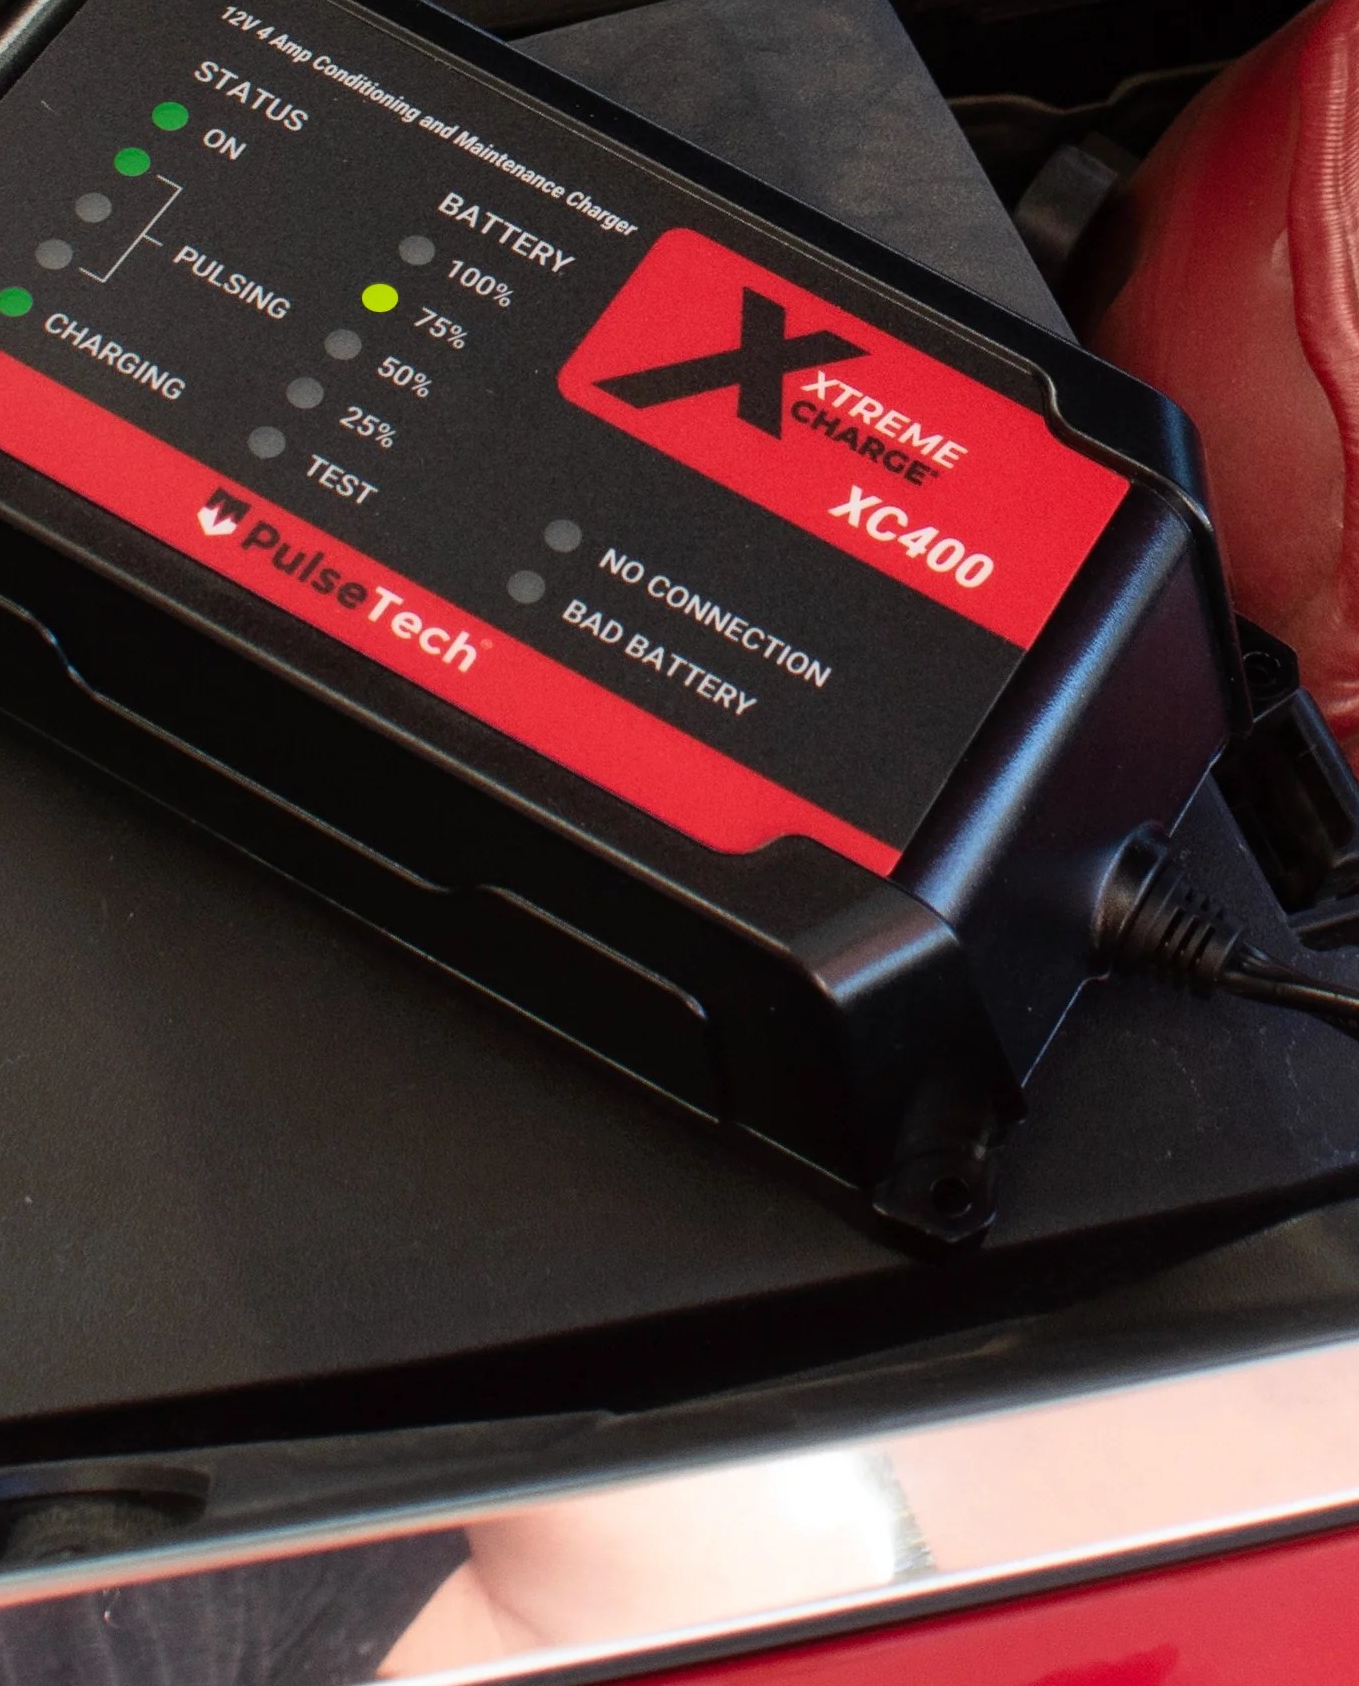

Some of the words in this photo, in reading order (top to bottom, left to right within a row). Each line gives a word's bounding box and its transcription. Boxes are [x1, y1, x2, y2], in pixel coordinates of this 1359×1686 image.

[194, 61, 310, 133] STATUS
[219, 6, 259, 33] 12V
[255, 25, 272, 40] 4
[268, 31, 313, 65] Amp
[312, 55, 422, 125] Conditioning
[418, 112, 459, 141] and
[452, 129, 566, 200] Maintenance
[565, 190, 639, 240] Charger
[202, 127, 247, 162] ON
[438, 191, 576, 274] BATTERY
[173, 245, 292, 320] PULSING
[447, 259, 514, 308] 100%
[44, 312, 186, 401] CHARGING
[413, 306, 468, 350] 75%
[377, 355, 433, 398] 50%
[339, 405, 397, 449] 25%
[802, 371, 969, 470] XTREME
[306, 453, 379, 505] TEST
[827, 484, 995, 591] XC400
[241, 520, 480, 674] PulseTech
[598, 547, 646, 585] NO
[648, 573, 833, 689] CONNECTION
[561, 598, 625, 645] BAD
[624, 631, 758, 716] BATTERY
